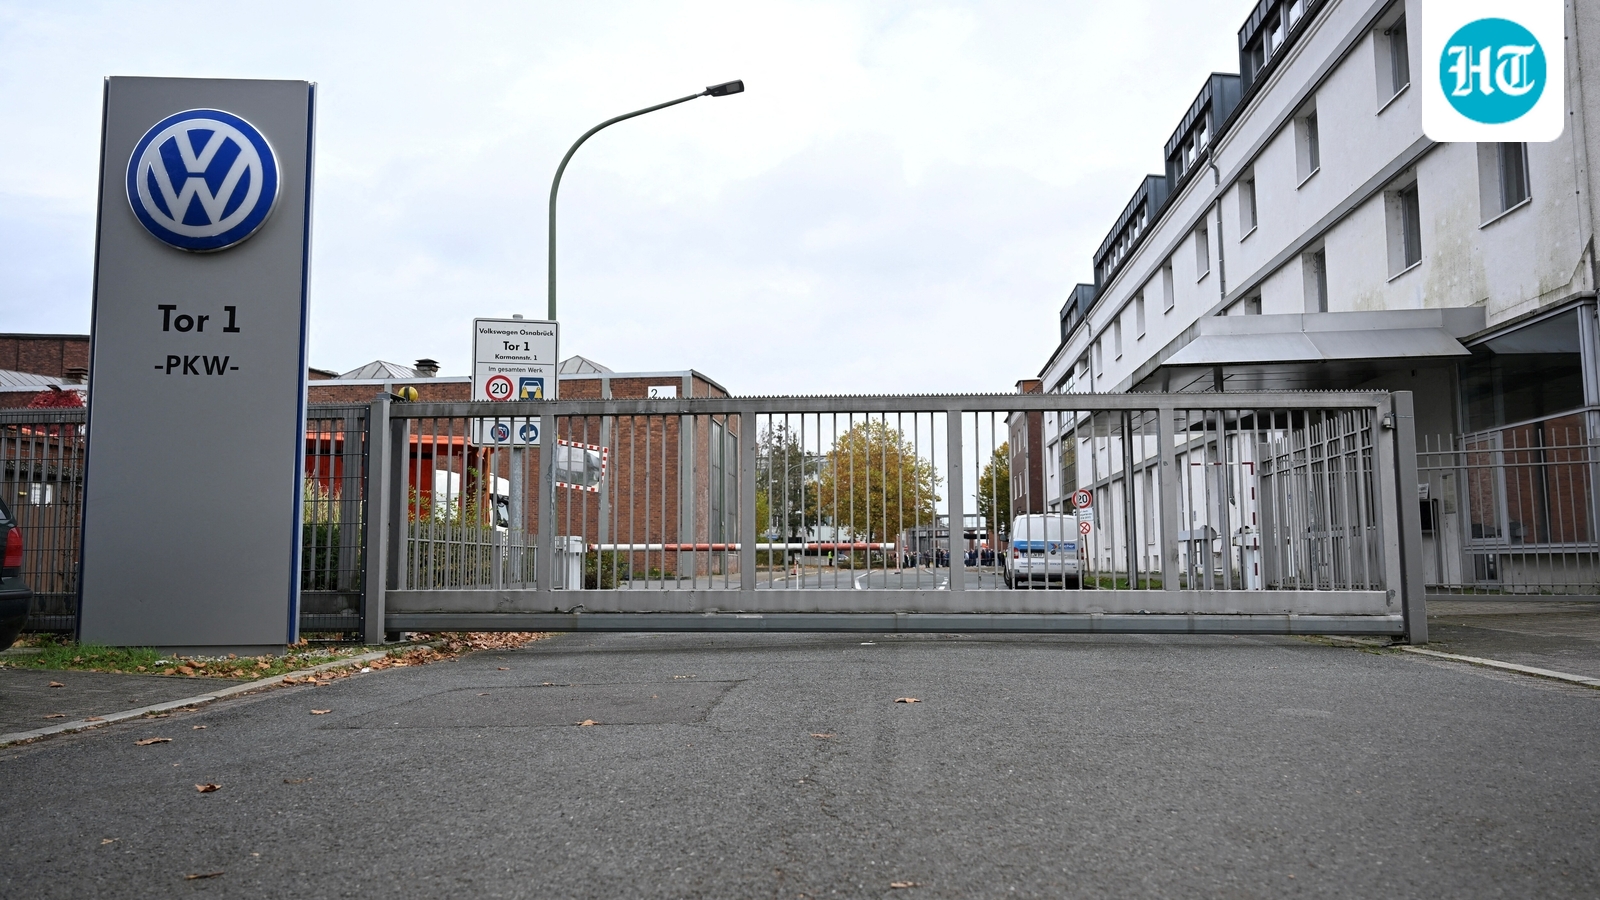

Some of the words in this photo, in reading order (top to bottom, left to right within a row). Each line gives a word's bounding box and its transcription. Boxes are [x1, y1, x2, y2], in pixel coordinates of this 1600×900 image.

[140, 119, 262, 236] VW
[158, 304, 210, 333] Tor
[223, 305, 240, 333] 1
[479, 328, 518, 336] Volkswagen
[503, 341, 520, 351] Tor
[524, 342, 530, 351] 1
[154, 354, 239, 376] -PKW-
[492, 382, 508, 394] 20
[650, 388, 658, 399] 2
